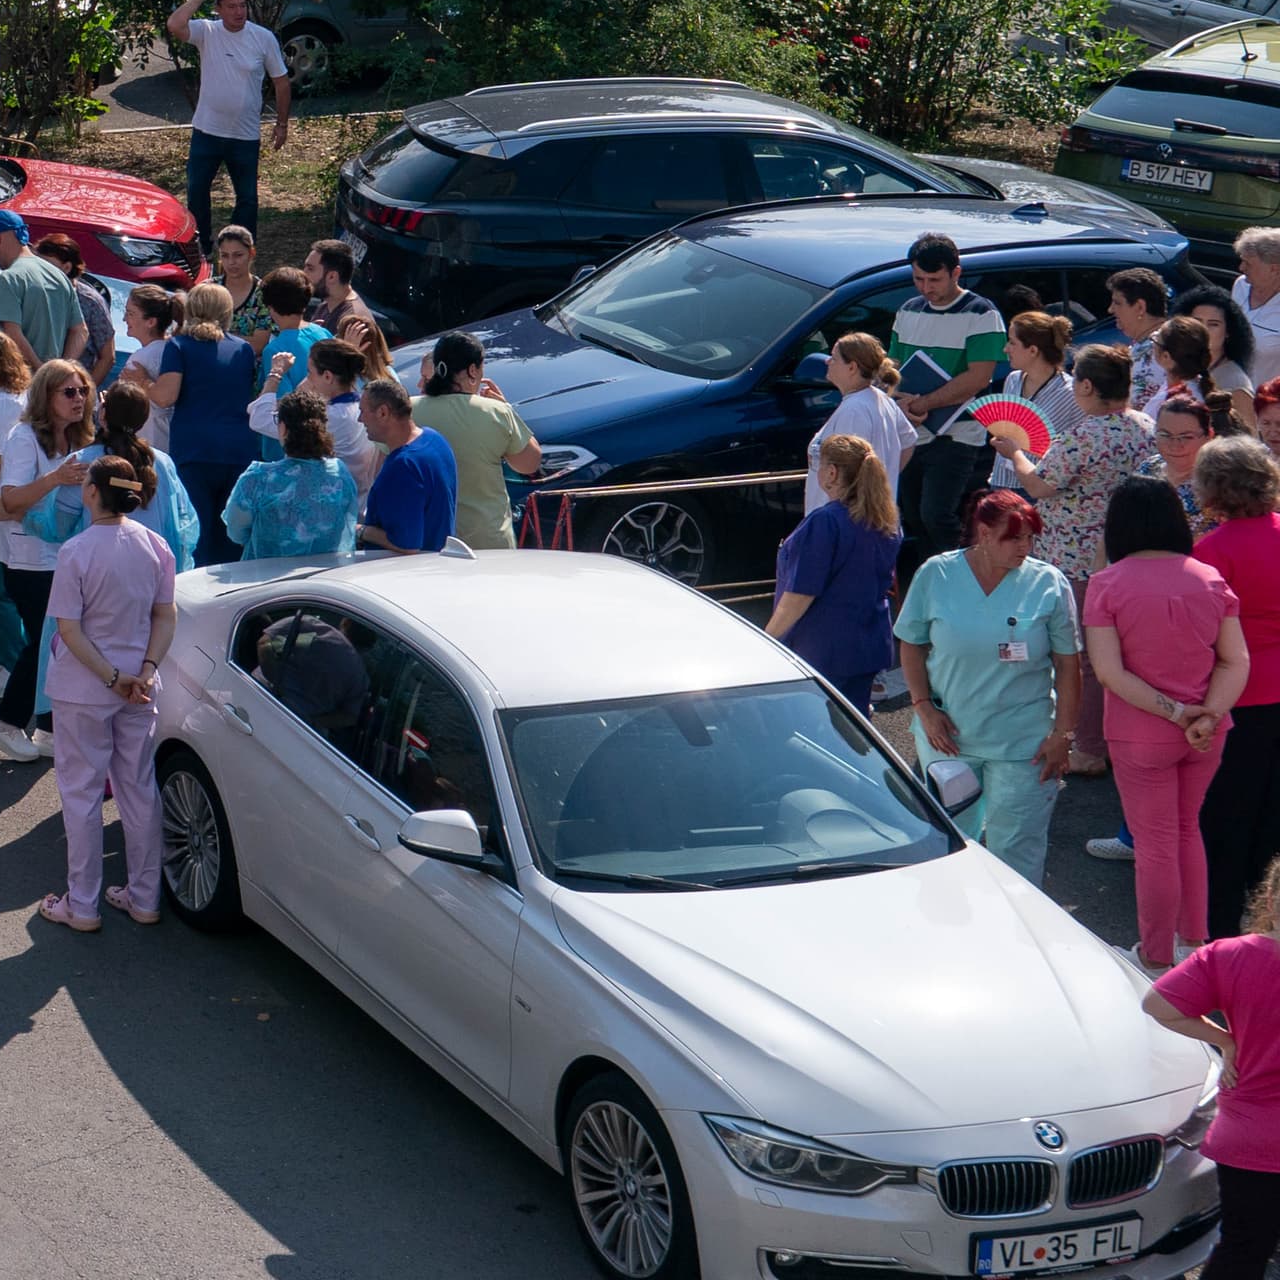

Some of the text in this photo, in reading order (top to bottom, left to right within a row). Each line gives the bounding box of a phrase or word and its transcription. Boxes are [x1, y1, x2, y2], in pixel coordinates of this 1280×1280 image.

[1130, 162, 1207, 188] B 517 HEY
[979, 1258, 991, 1270] RO
[1000, 1240, 1034, 1269] VL
[1047, 1233, 1078, 1263] 35
[1093, 1225, 1132, 1257] FIL
